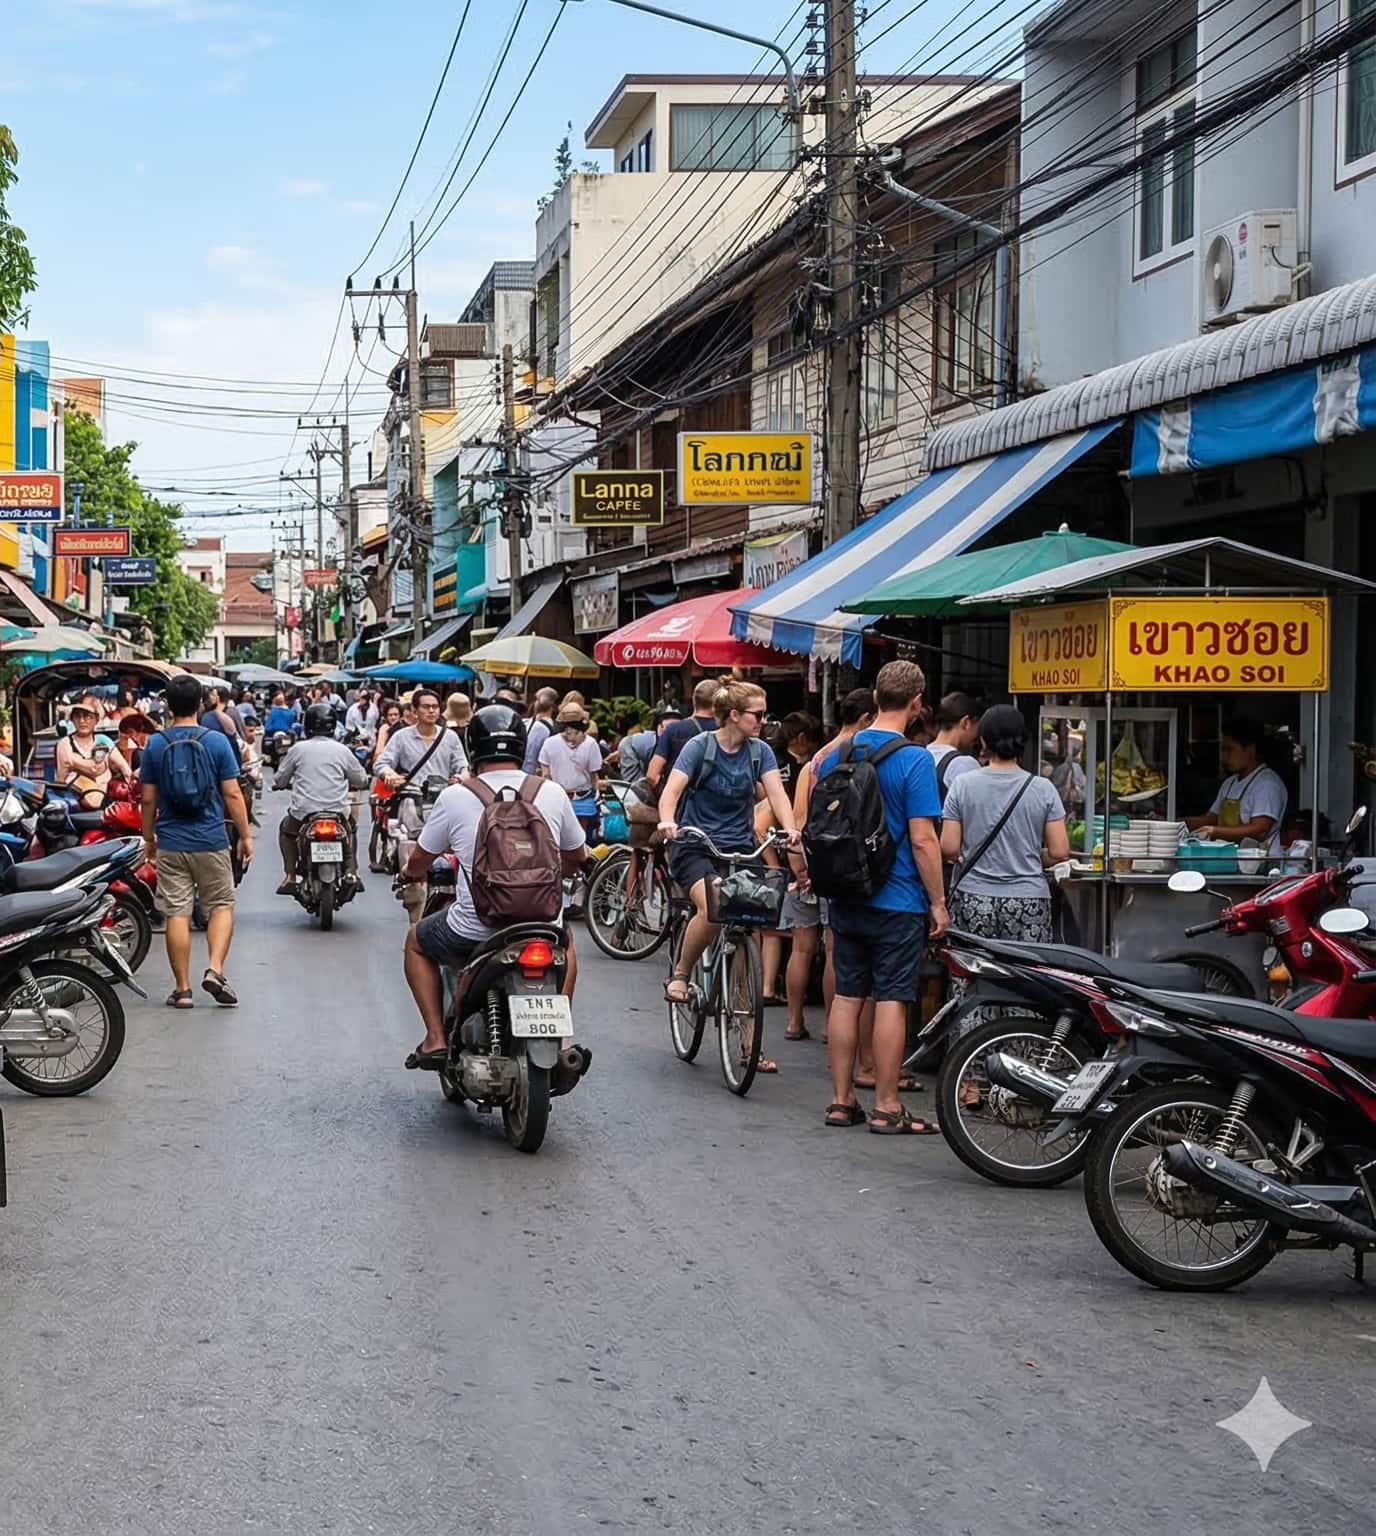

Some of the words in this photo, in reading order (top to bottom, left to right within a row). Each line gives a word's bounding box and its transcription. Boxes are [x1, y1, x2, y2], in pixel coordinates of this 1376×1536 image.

[581, 478, 654, 498] Lanna
[1032, 669, 1059, 686] KHAO
[1063, 667, 1080, 685] SOI
[1154, 665, 1231, 683] KHAO
[1239, 665, 1285, 683] SOI
